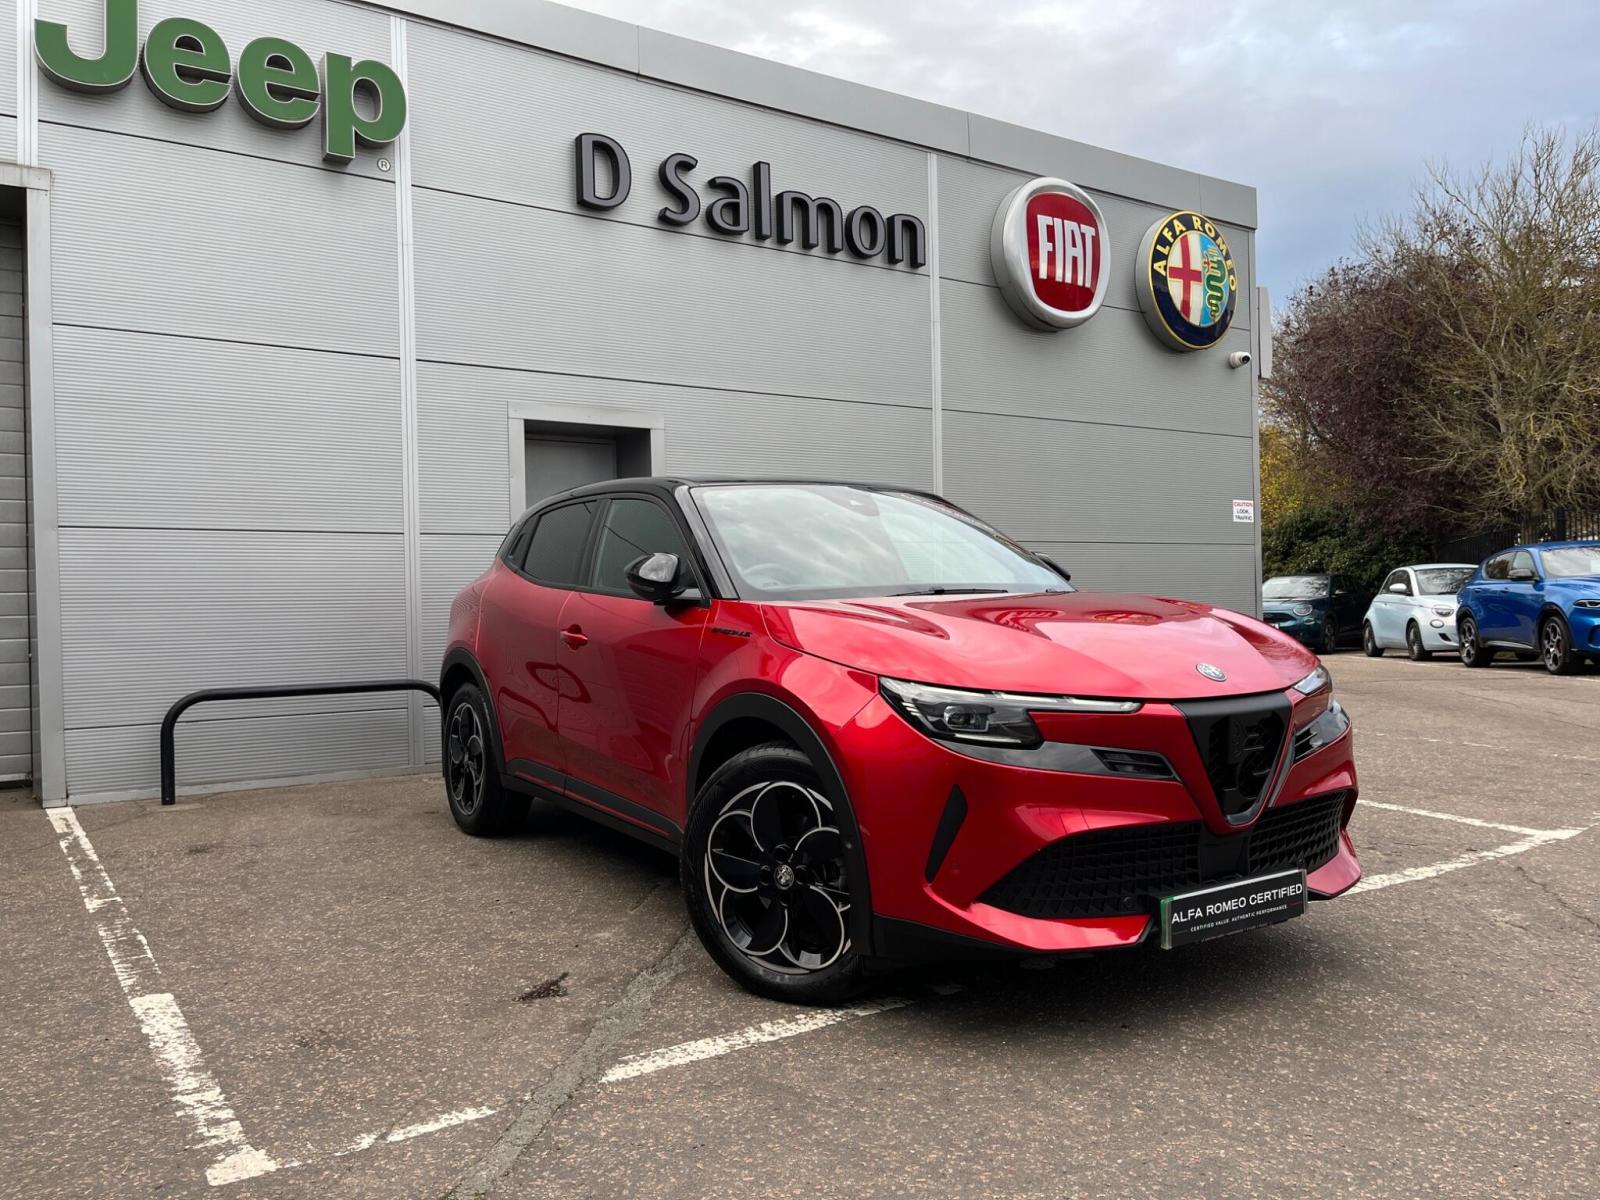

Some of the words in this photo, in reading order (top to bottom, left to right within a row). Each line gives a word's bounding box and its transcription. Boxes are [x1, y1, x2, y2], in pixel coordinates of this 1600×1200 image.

[34, 0, 408, 164] Jeep
[575, 132, 632, 210] D
[657, 152, 926, 269] Salmon
[1037, 214, 1096, 288] FIAT
[1153, 218, 1186, 277] ALFA
[1192, 215, 1237, 292] ROMEO
[1171, 907, 1204, 925] ALFA
[1206, 897, 1247, 916] ROMEO
[1249, 883, 1303, 905] CERTIFIED
[1190, 922, 1215, 932] CERTIFIED
[1231, 911, 1256, 922] AUTHENTIC
